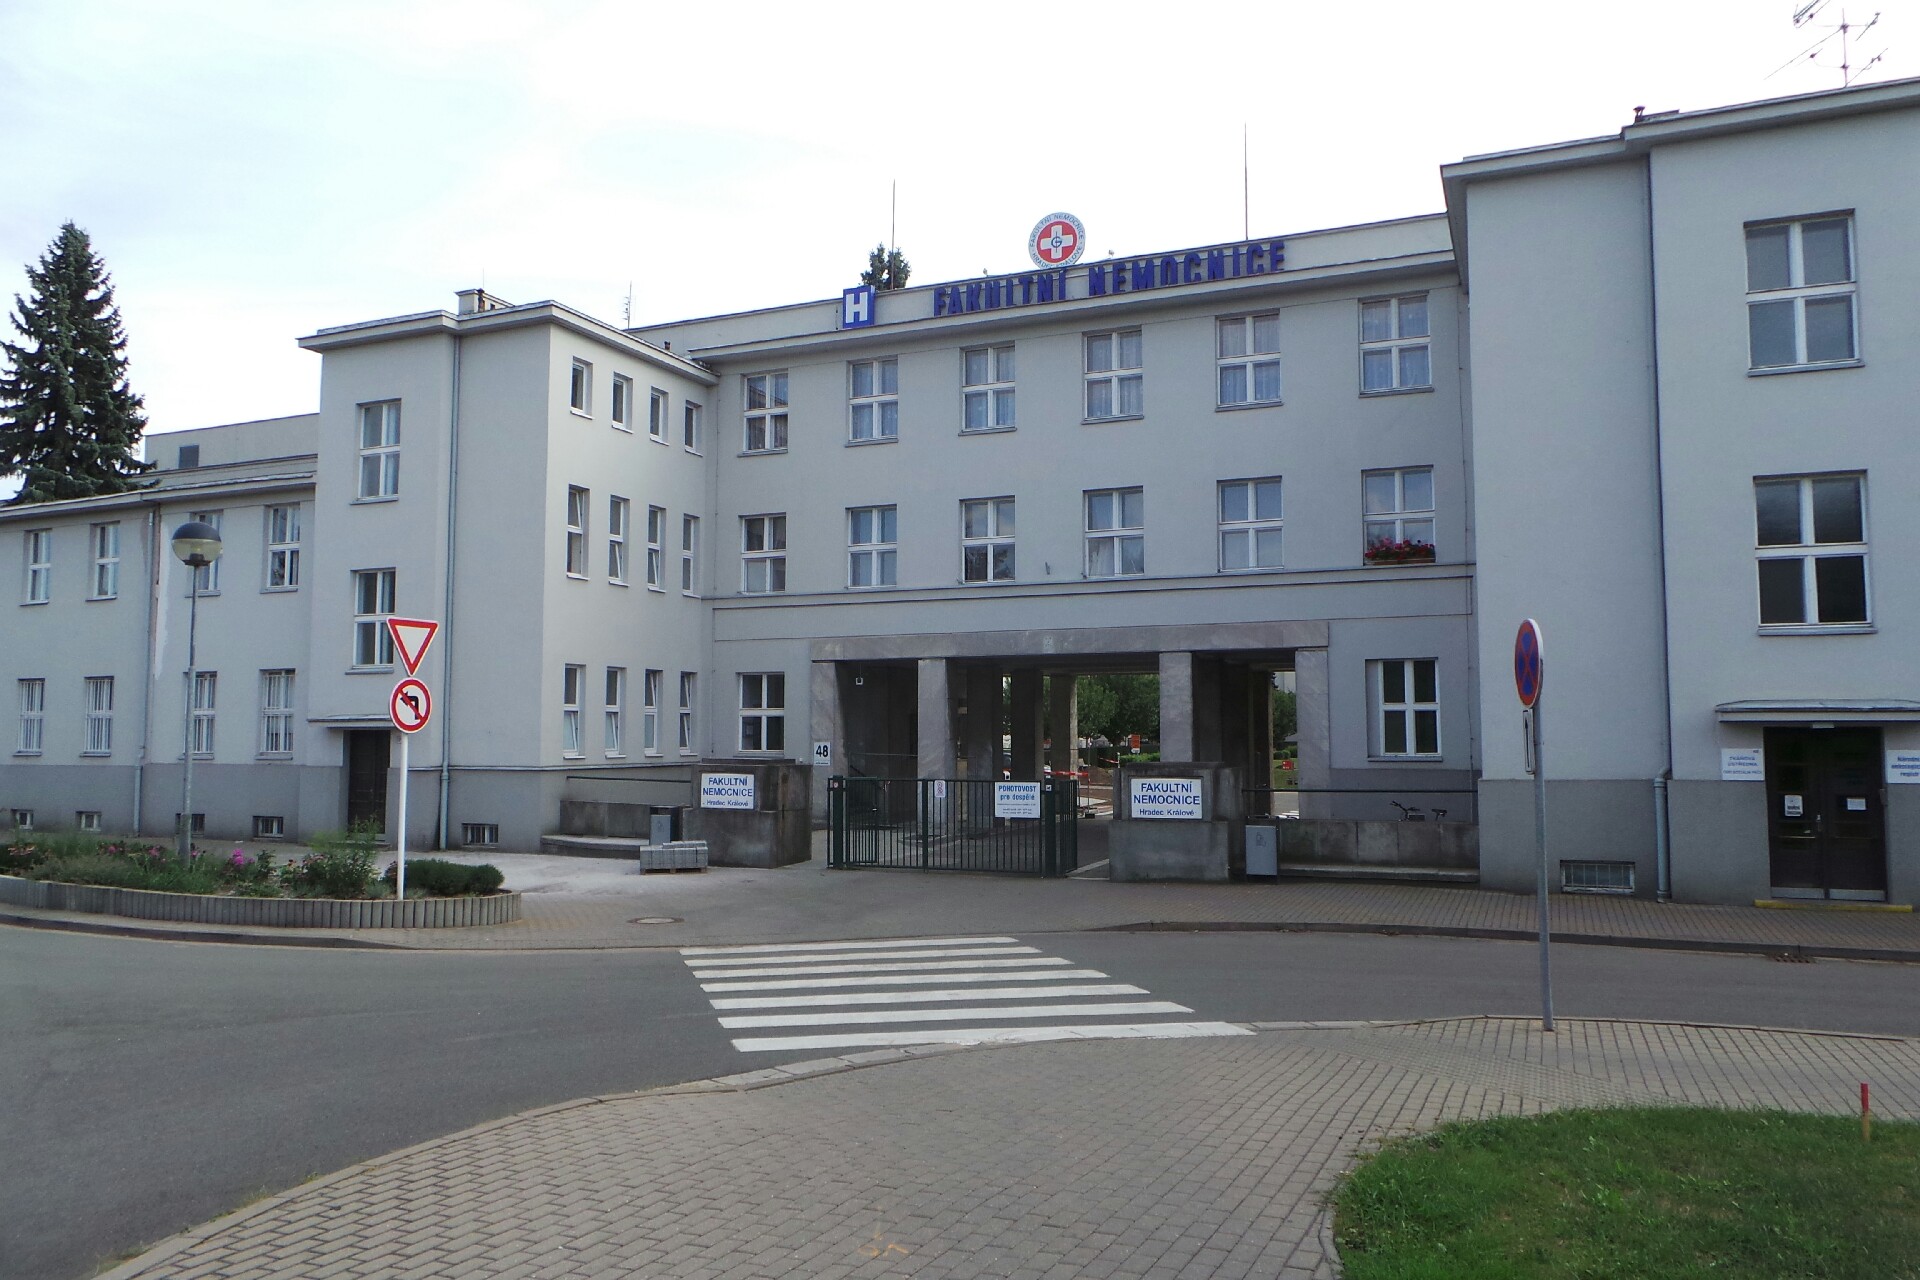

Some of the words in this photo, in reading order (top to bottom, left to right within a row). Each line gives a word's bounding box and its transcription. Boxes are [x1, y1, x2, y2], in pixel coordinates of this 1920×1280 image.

[1088, 240, 1285, 297] NEMOCNICE
[845, 291, 869, 324] H
[815, 744, 829, 758] 48
[708, 775, 748, 786] FAKULTNÍ
[702, 787, 753, 797] NEMOCNICE
[998, 785, 1037, 793] POHOTOVOST
[1141, 781, 1192, 793] FAKULTNÍ
[727, 799, 749, 807] Králové
[1133, 794, 1200, 805] NEMOCNICE
[1139, 808, 1164, 816] Hradec
[1166, 808, 1195, 816] Králové
